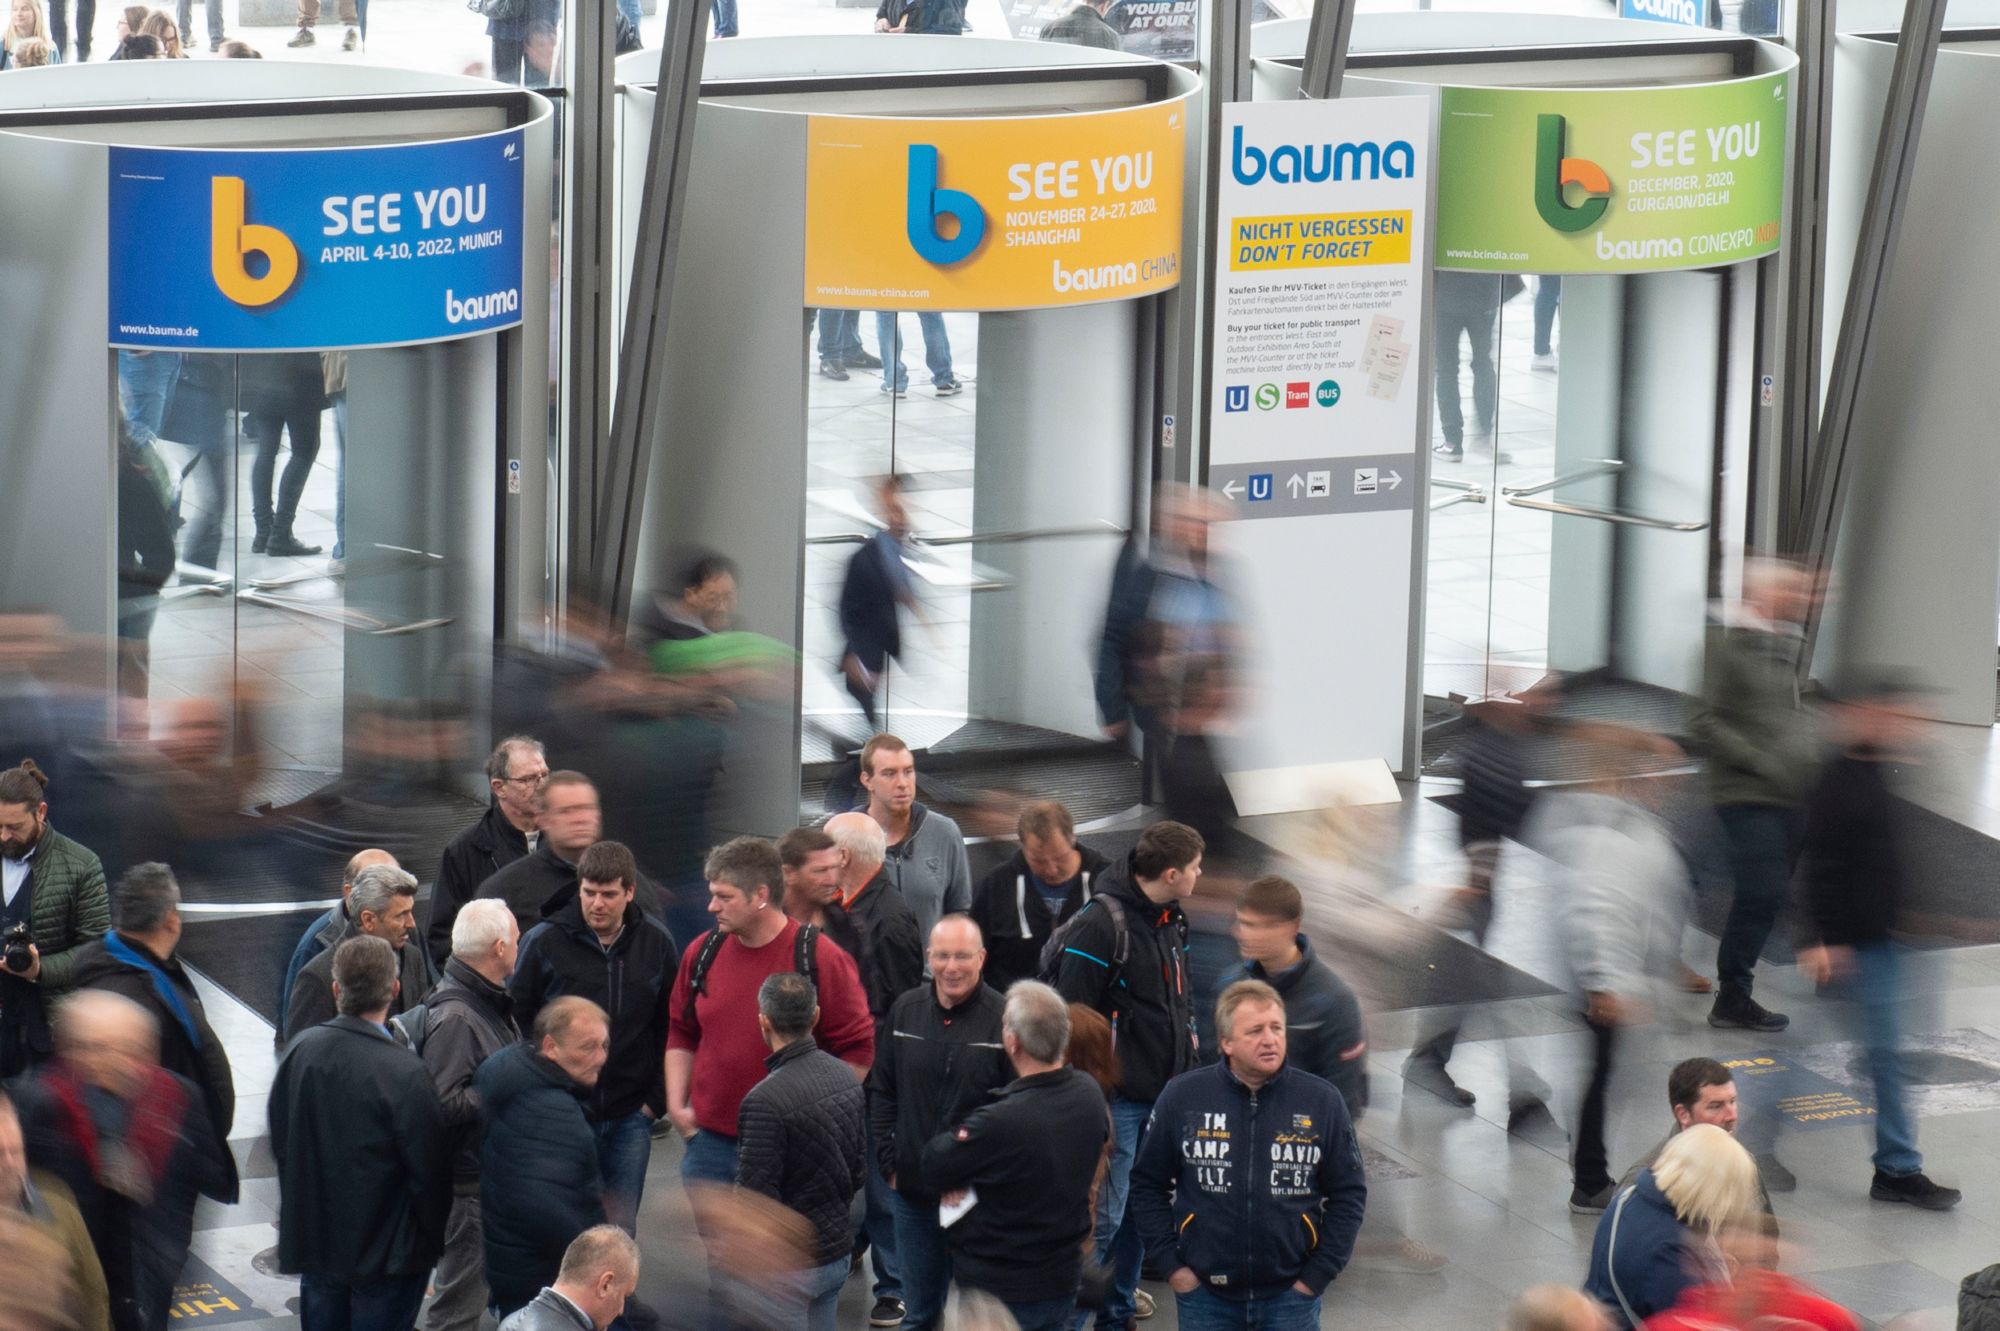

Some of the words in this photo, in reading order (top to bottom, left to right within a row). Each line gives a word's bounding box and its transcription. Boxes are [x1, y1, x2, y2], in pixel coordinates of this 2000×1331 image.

[1127, 2, 1171, 16] YOUR
[1633, 0, 1696, 25] auma
[1129, 16, 1153, 29] AT
[1154, 15, 1189, 28] OUR
[1232, 125, 1415, 186] bauma
[1630, 130, 1696, 169] SEE
[1706, 121, 1761, 162] YOU
[1007, 161, 1080, 201] SEE
[1090, 151, 1153, 195] YOU
[1628, 175, 1701, 195] DECEMBER,
[1705, 172, 1735, 188] 2020,
[322, 193, 401, 236] SEE
[413, 183, 487, 229] YOU
[1005, 208, 1086, 227] NOVEMBER
[1090, 204, 1127, 223] 24-27,
[1129, 198, 1158, 217] 2020,
[1627, 193, 1730, 213] GURGAON/DELHI
[1005, 229, 1081, 248] SHANGHAI
[1239, 222, 1294, 241] NICHT
[1299, 217, 1404, 238] VERGESSEN
[321, 244, 370, 264] APRIL
[373, 241, 412, 262] 4-10,
[416, 236, 456, 258] 2022,
[458, 229, 502, 254] MUNICH
[1301, 240, 1373, 260] FORGET
[1446, 248, 1529, 261] www.bcindia.com
[1597, 231, 1684, 261] bauma
[1688, 227, 1753, 255] CONEXPO
[1053, 260, 1136, 293] bauma
[1141, 252, 1177, 283] CHINA
[816, 285, 930, 299] www.bauma-china.com
[1228, 286, 1257, 295] Kaufen
[1258, 285, 1270, 294] Sie
[1272, 285, 1282, 293] Ihr
[446, 288, 518, 325] bauma
[119, 323, 199, 338] www.bauma.de
[1227, 324, 1243, 333] Buy
[1244, 325, 1262, 333] your
[1264, 322, 1286, 331] ticket
[1287, 321, 1298, 329] for
[1300, 319, 1324, 329] public
[1325, 318, 1361, 328] transport
[1229, 389, 1245, 410] U
[1287, 389, 1309, 400] Tram
[1318, 388, 1338, 399] BUS
[1253, 479, 1268, 498] U
[1182, 1140, 1230, 1159] CAMP
[1270, 1143, 1322, 1165] DAVID
